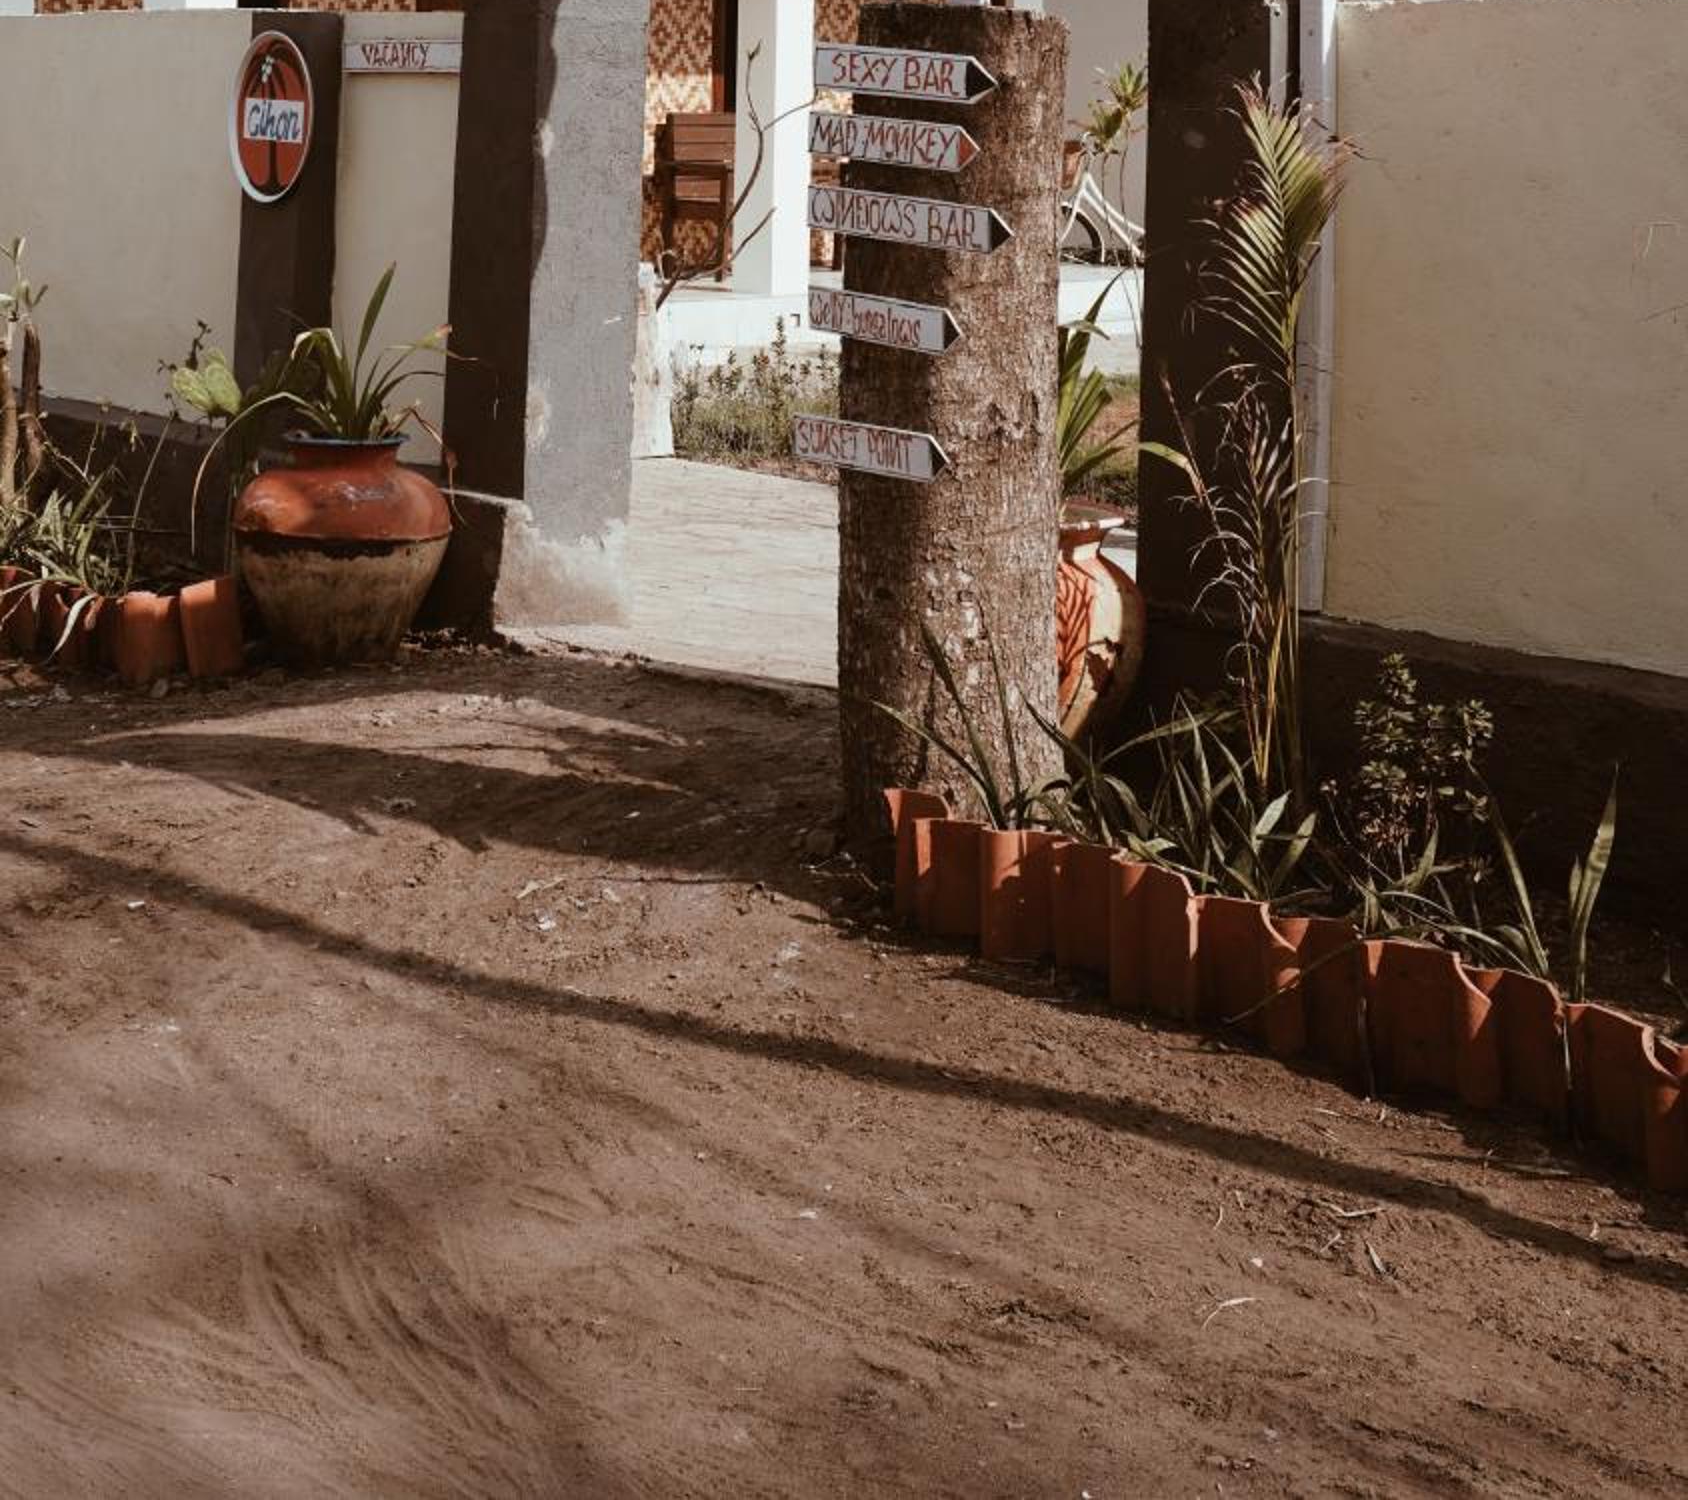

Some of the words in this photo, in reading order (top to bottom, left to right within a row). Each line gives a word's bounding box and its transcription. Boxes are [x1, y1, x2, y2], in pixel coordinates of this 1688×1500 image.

[361, 37, 431, 69] VACANCY
[831, 53, 897, 87] SEXY
[903, 57, 961, 96] BAR
[809, 116, 859, 156] MAD
[862, 121, 959, 167] MONKEY
[811, 189, 917, 238] WINDOWS
[927, 206, 983, 249] BAR
[797, 420, 860, 460] SUNSET
[865, 428, 913, 473] POINT
